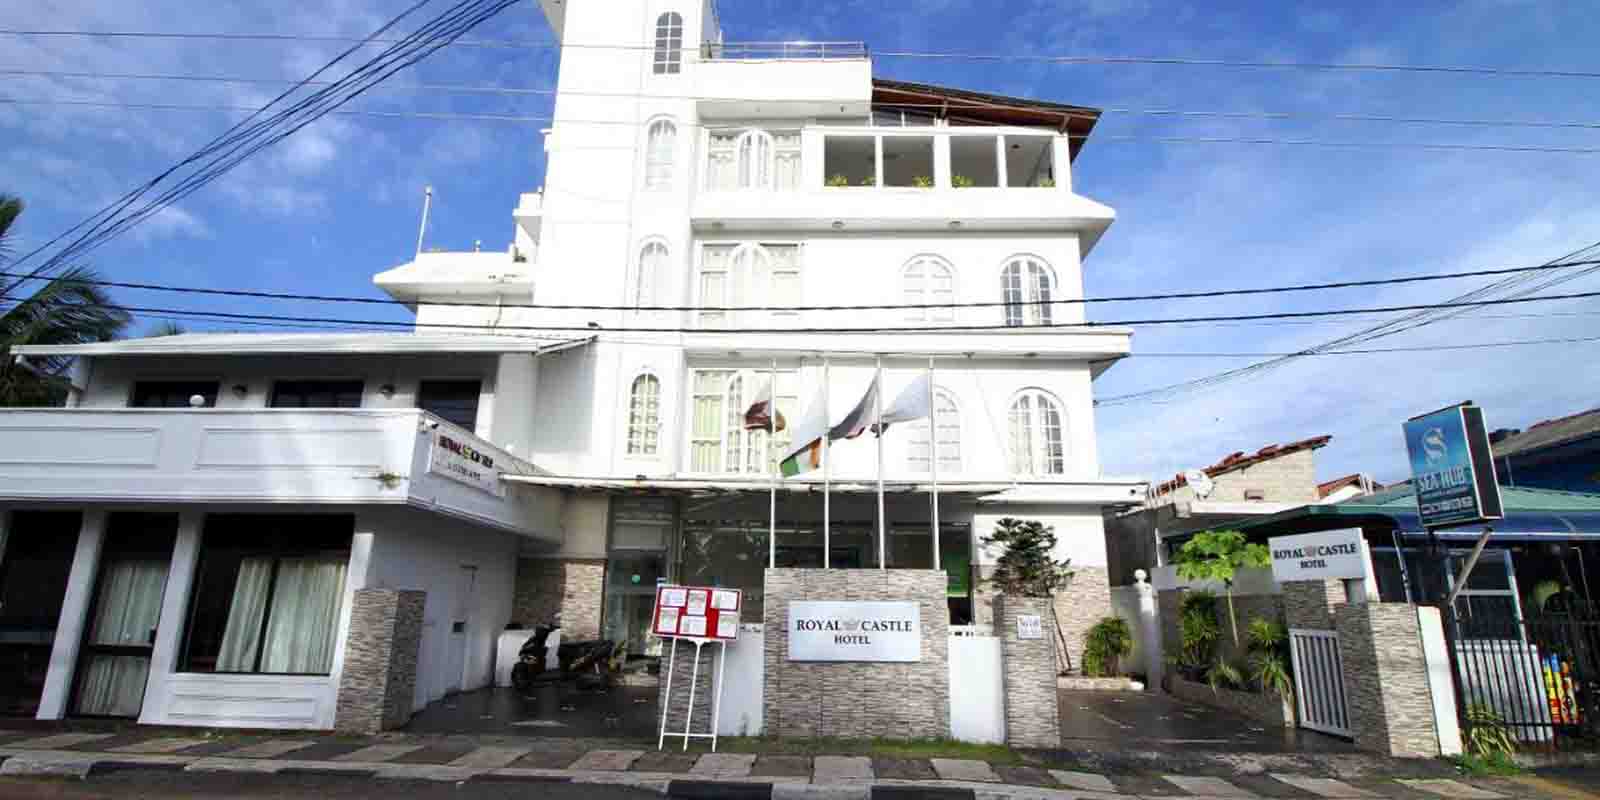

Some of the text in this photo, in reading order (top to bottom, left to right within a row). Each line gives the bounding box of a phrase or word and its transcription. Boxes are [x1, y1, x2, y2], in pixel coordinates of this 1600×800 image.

[1440, 464, 1466, 488] HUB
[1273, 543, 1356, 560] ROYAL CASTLE
[1300, 560, 1327, 569] HOTEL
[796, 619, 913, 632] ROYAL CASTLE
[834, 635, 871, 645] HOTEL
